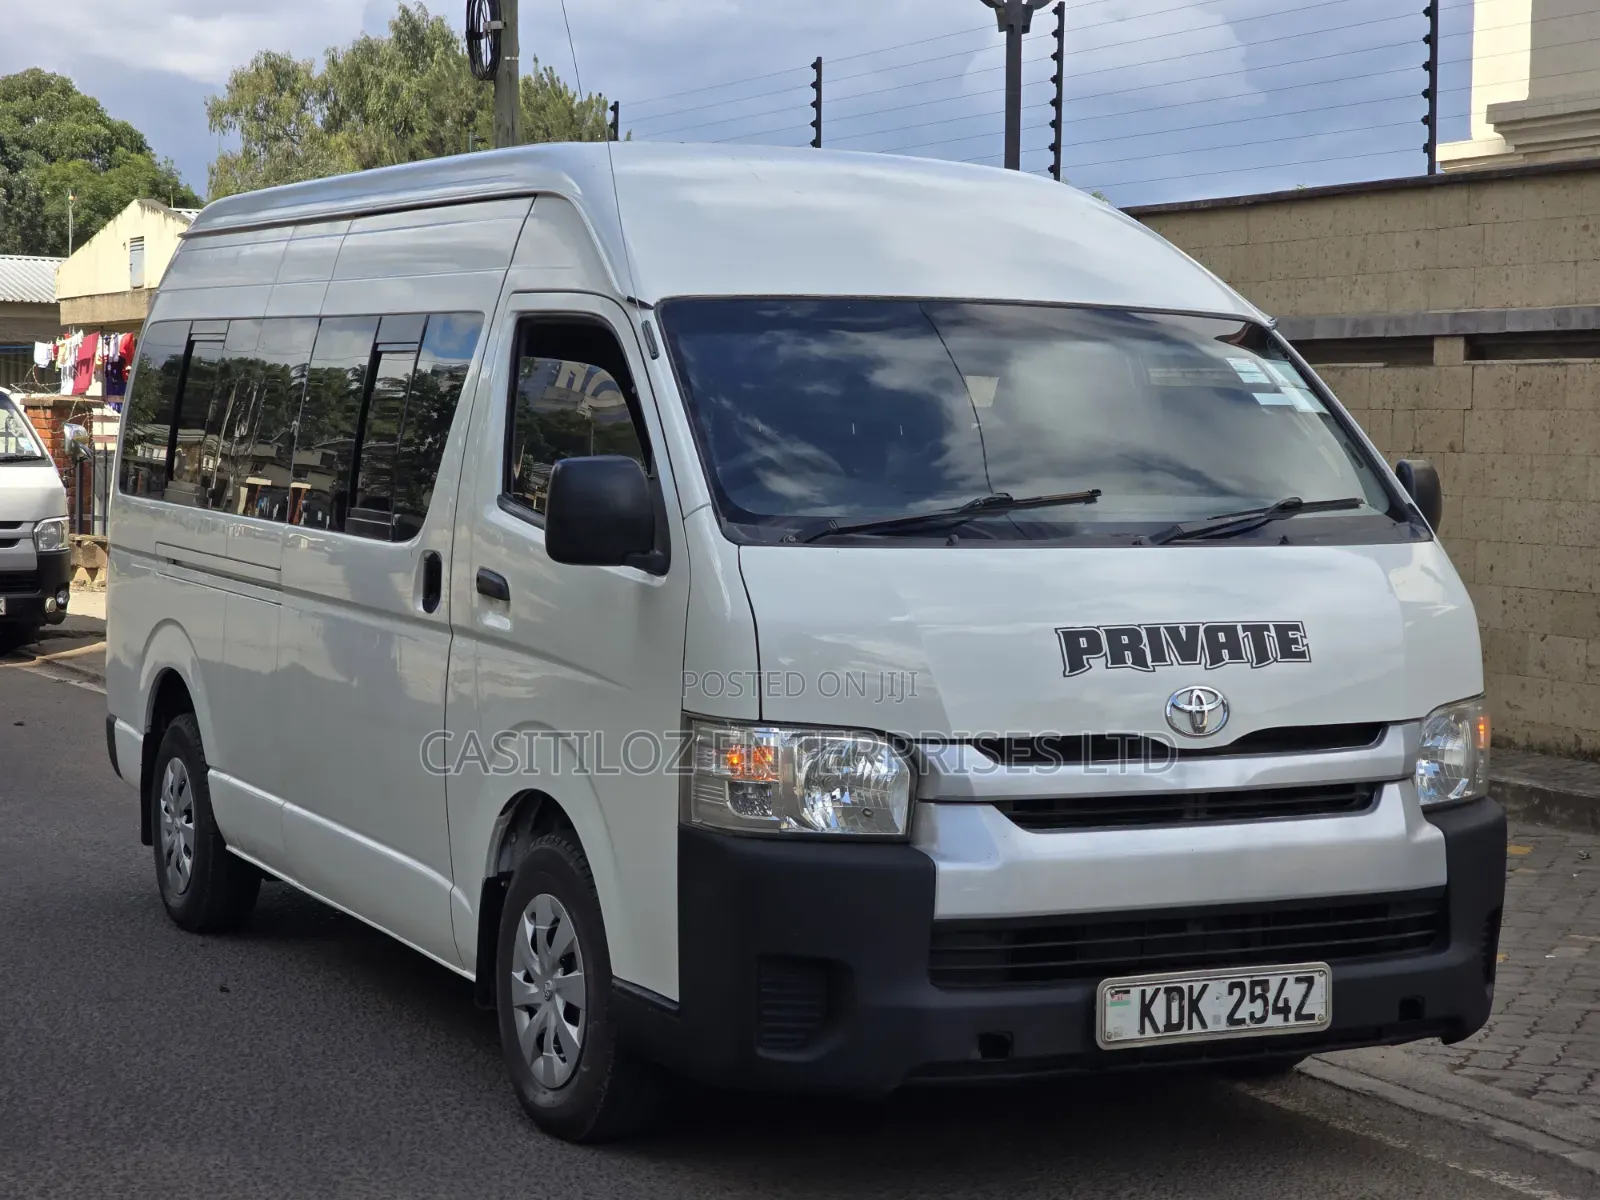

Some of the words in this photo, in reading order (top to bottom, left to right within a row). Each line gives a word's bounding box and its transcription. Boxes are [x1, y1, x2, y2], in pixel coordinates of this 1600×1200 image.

[1055, 621, 1312, 677] PRIVATE
[1138, 983, 1209, 1035] KDK
[1226, 976, 1316, 1027] 254Z
